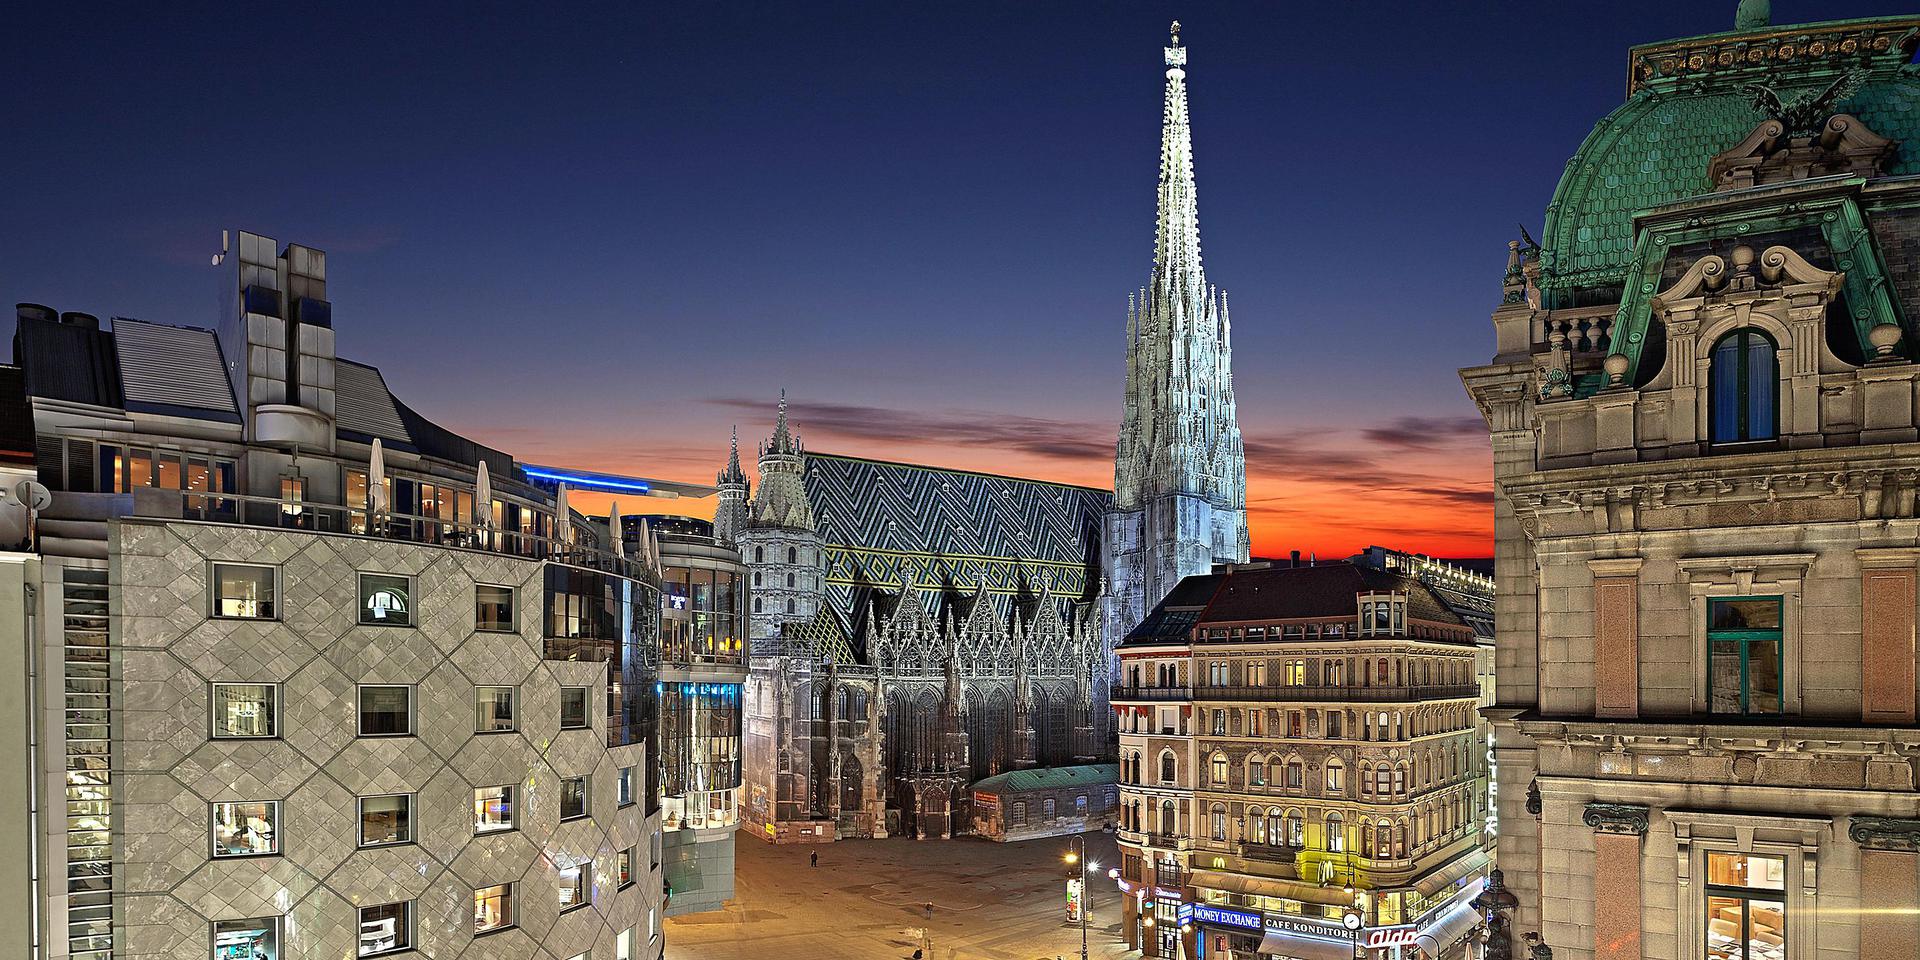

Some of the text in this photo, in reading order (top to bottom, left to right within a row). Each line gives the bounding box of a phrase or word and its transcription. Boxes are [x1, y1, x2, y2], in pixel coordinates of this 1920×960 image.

[1194, 907, 1220, 922] MONEY
[1221, 912, 1261, 928] EXCHANGE
[1293, 922, 1360, 940] KONDITOREI
